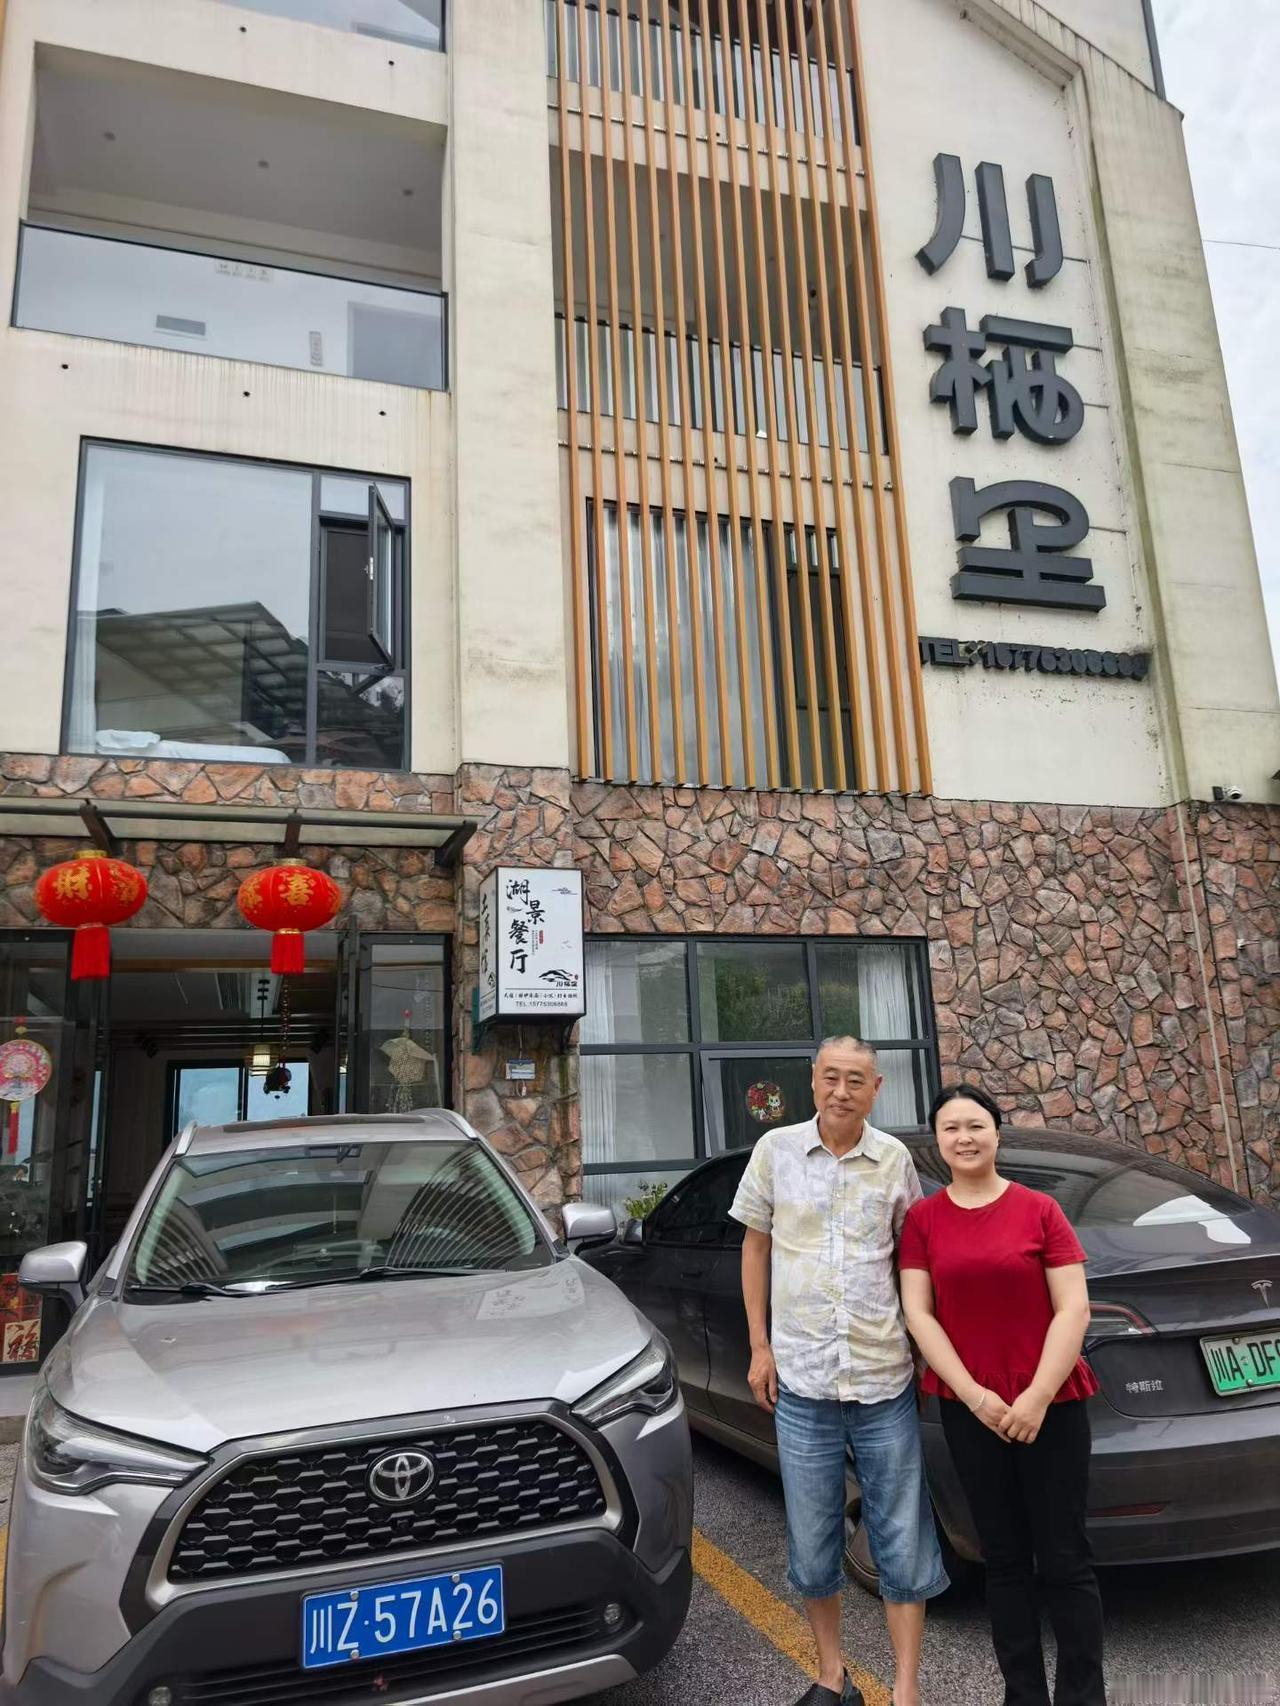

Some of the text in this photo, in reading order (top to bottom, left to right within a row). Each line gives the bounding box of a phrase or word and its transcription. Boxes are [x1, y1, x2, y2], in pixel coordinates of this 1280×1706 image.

[506, 879, 546, 974] 湖景餐厅
[1125, 1380, 1164, 1394] 特斯拉
